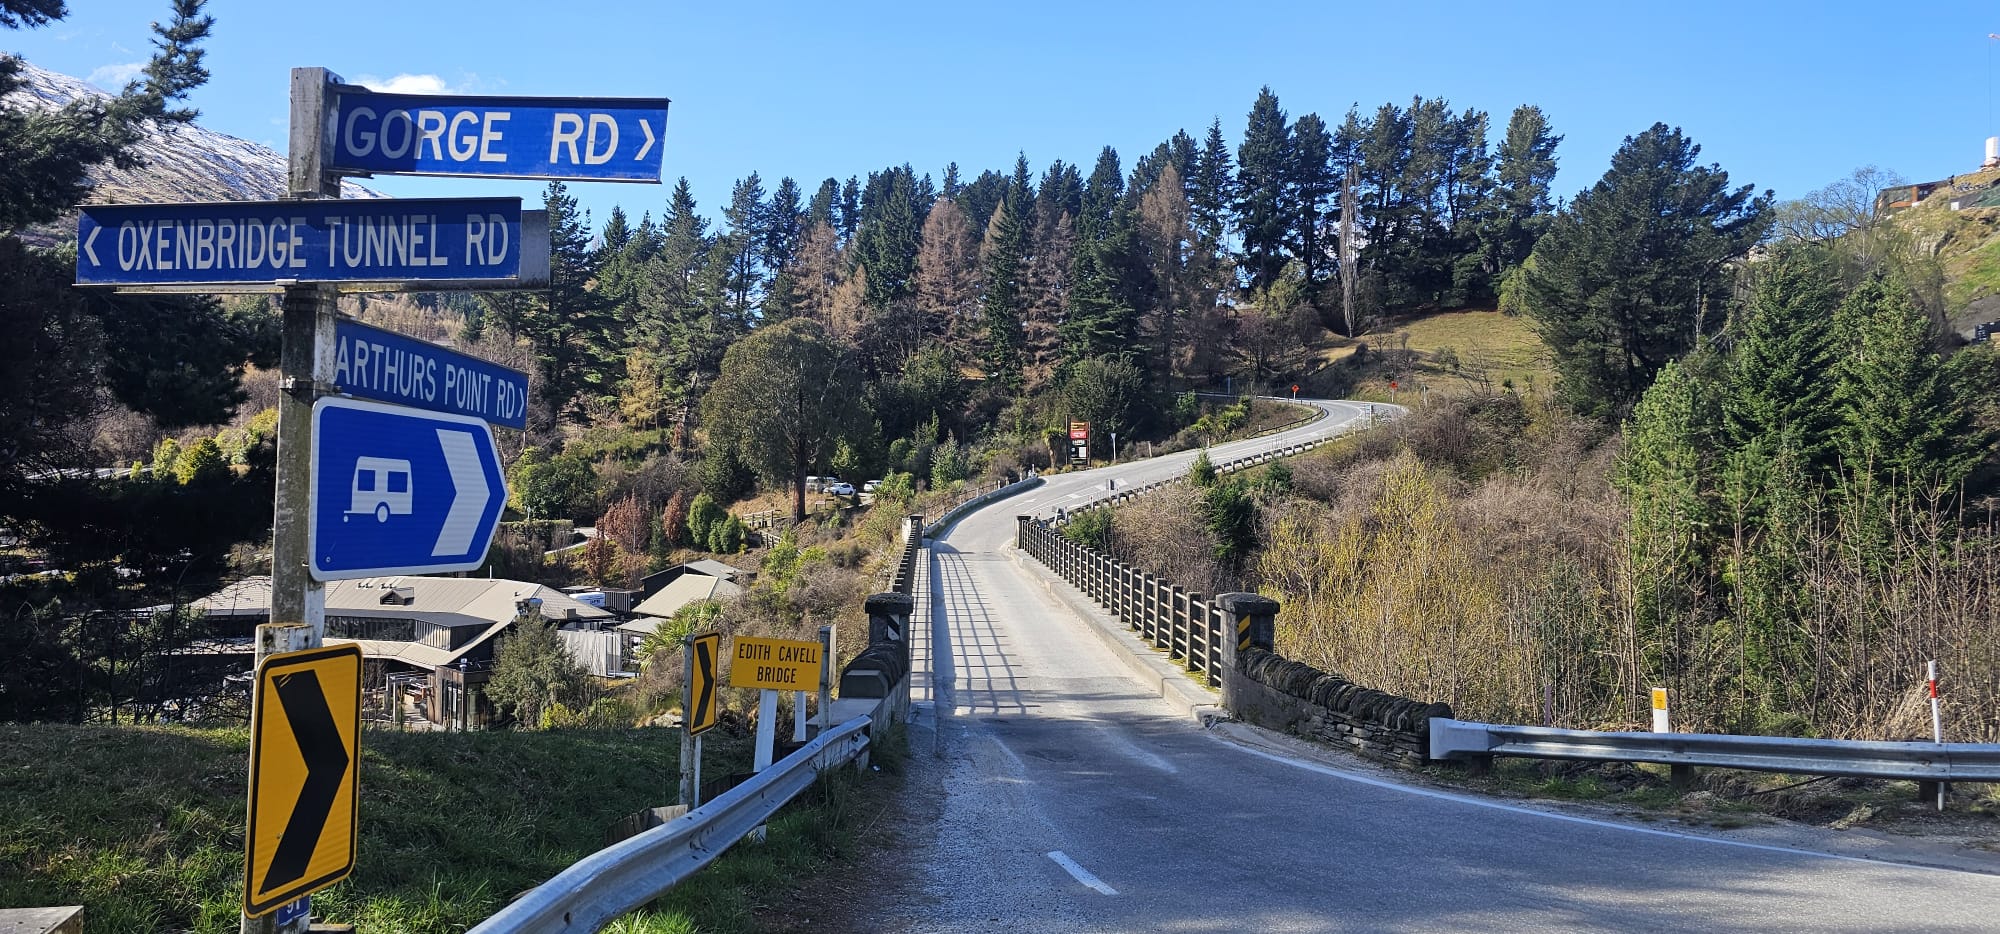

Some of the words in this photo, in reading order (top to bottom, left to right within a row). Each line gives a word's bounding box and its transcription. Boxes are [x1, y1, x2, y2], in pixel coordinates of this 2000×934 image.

[344, 107, 511, 163] GORGE
[549, 113, 620, 165] RD
[117, 216, 307, 272] OXENBRIDGE
[324, 214, 448, 268] TUNNEL
[465, 213, 510, 266] RD
[335, 335, 437, 402] ARTHURS
[444, 363, 491, 414] POINT
[496, 379, 516, 420] RD
[739, 643, 771, 660] EDITH
[778, 646, 817, 663] CAVELL
[757, 666, 797, 683] BRIDGE
